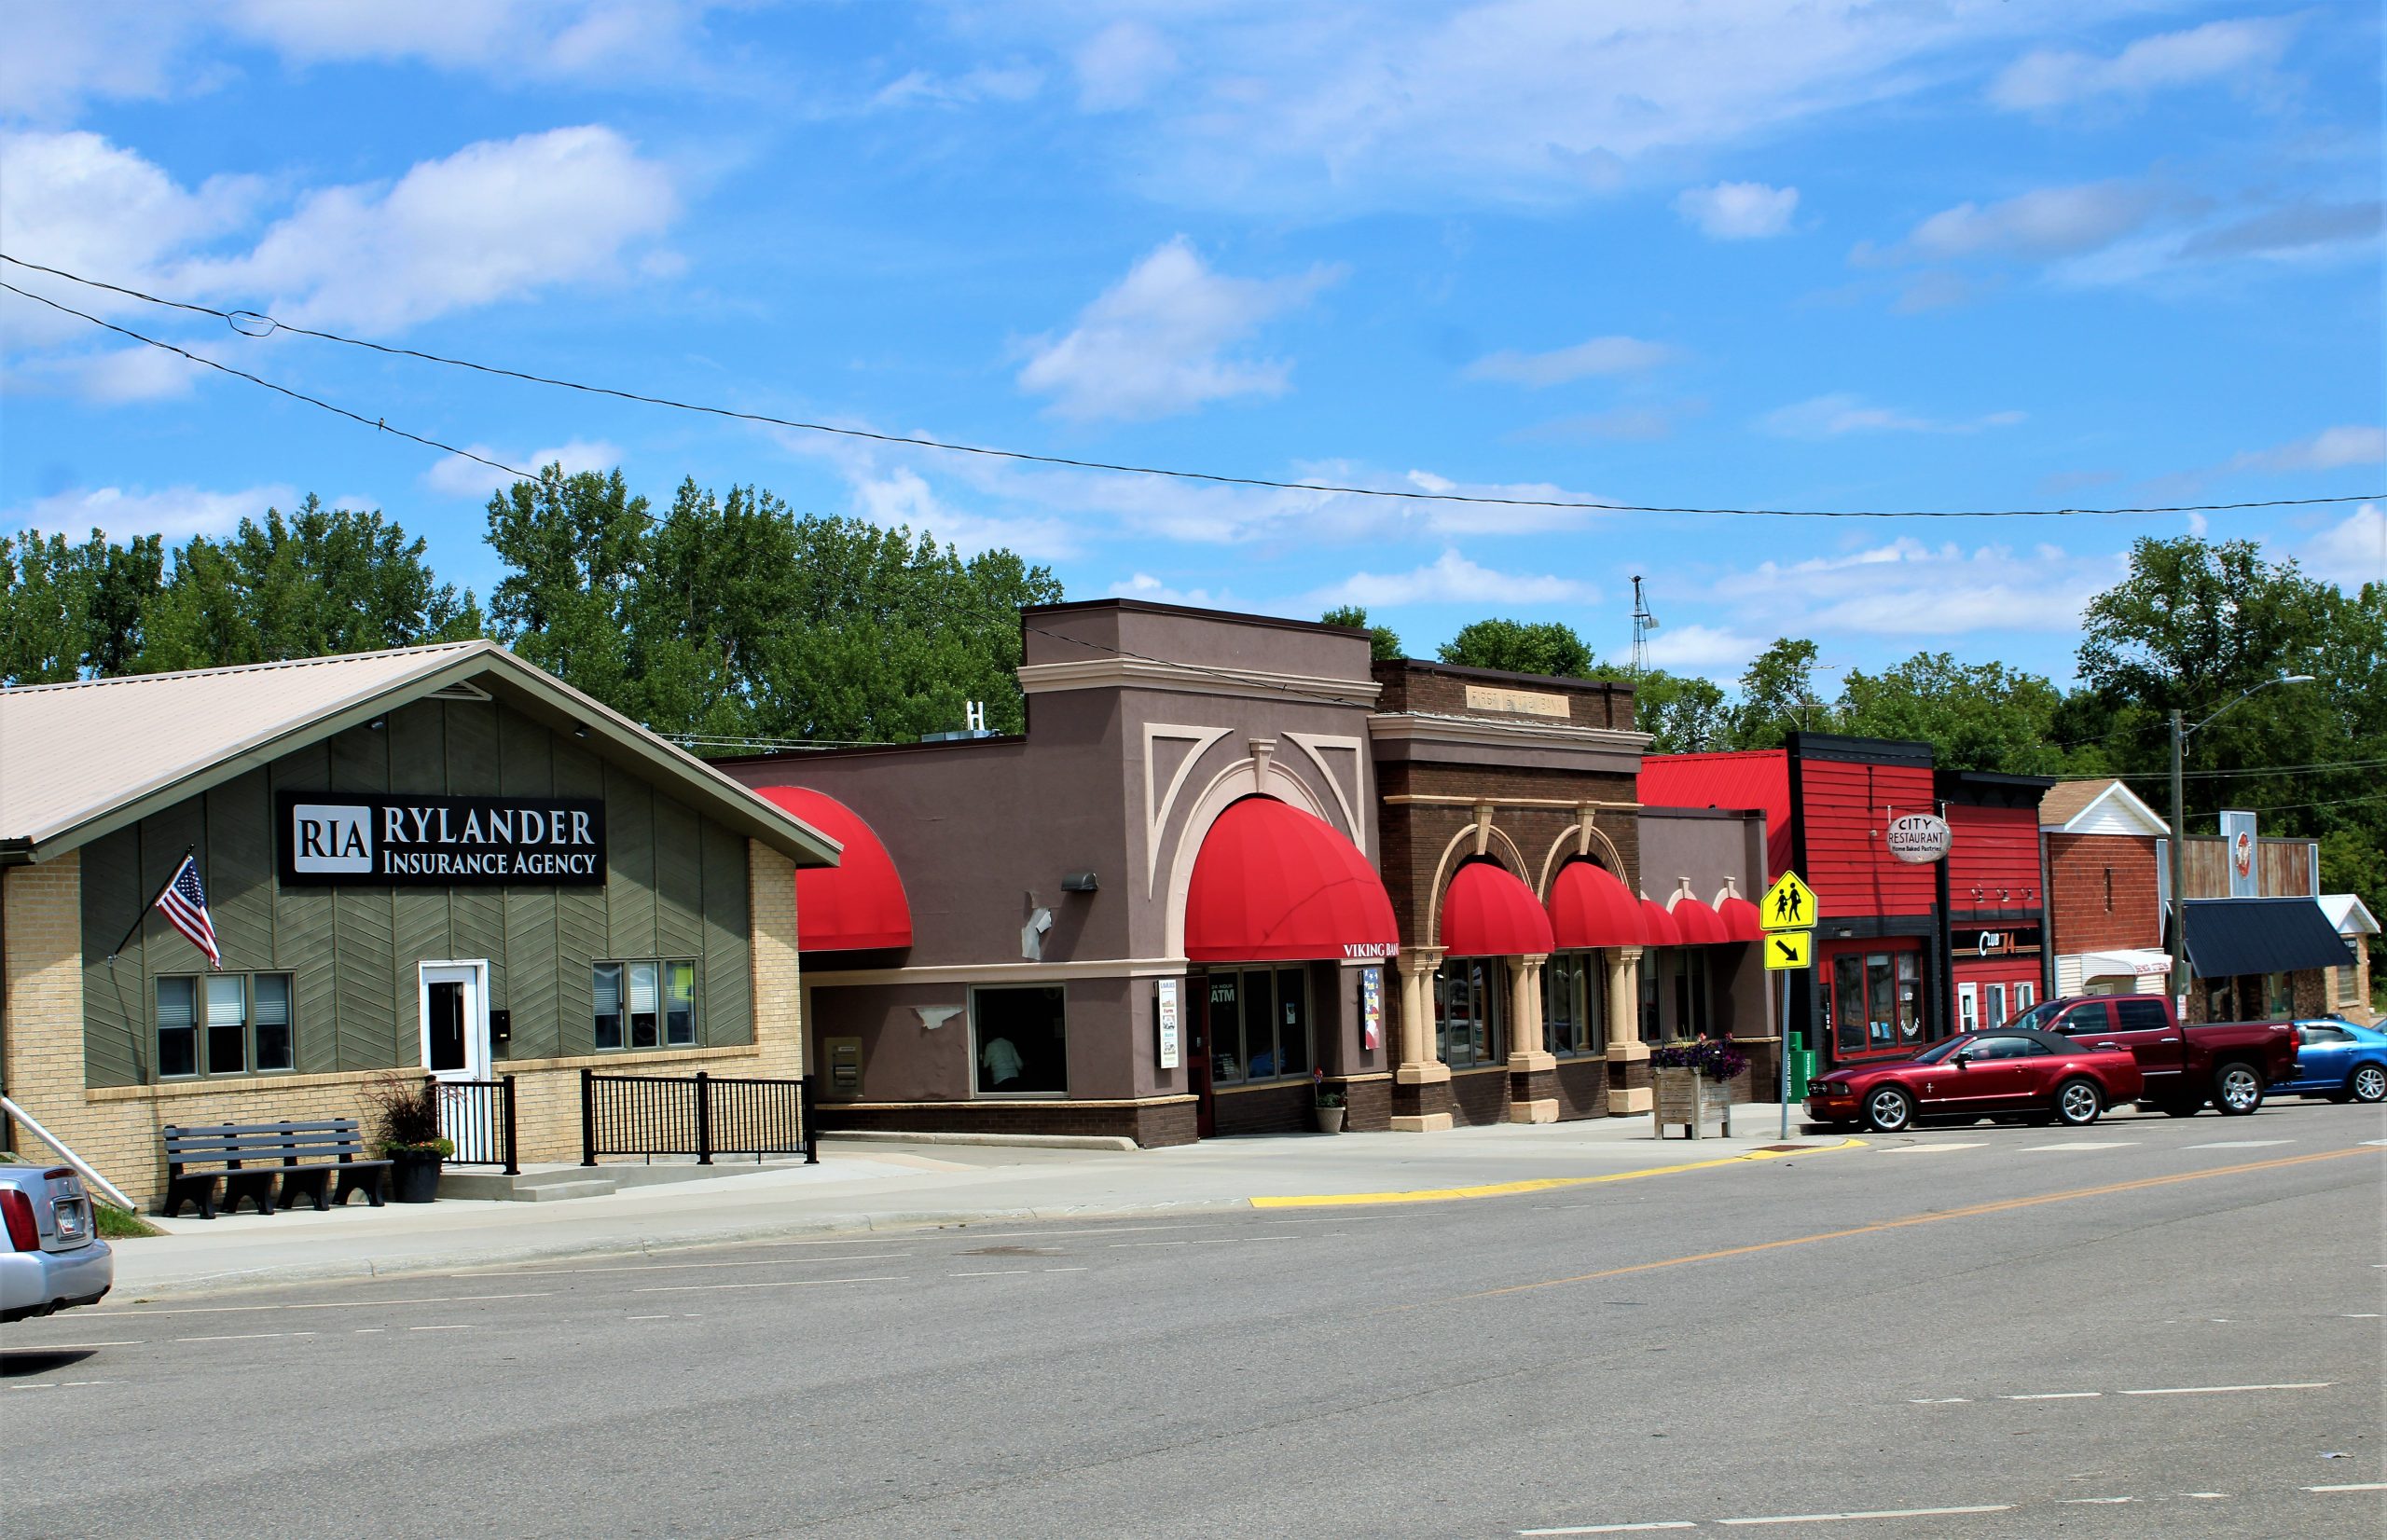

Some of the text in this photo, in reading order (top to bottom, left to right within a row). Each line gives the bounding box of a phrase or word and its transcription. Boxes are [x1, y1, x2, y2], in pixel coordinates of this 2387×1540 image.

[1471, 691, 1497, 706] FIRST
[1506, 694, 1534, 709] STATE
[382, 806, 596, 845] RYLANDER
[1898, 818, 1932, 830] CITY
[298, 819, 370, 859] RIA
[1889, 832, 1943, 844] RESTAURANT
[382, 849, 598, 874] INSURANCE AGENCY
[1344, 943, 1385, 957] VIKING
[2000, 931, 2015, 955] 74
[1210, 989, 1235, 1003] ATM
